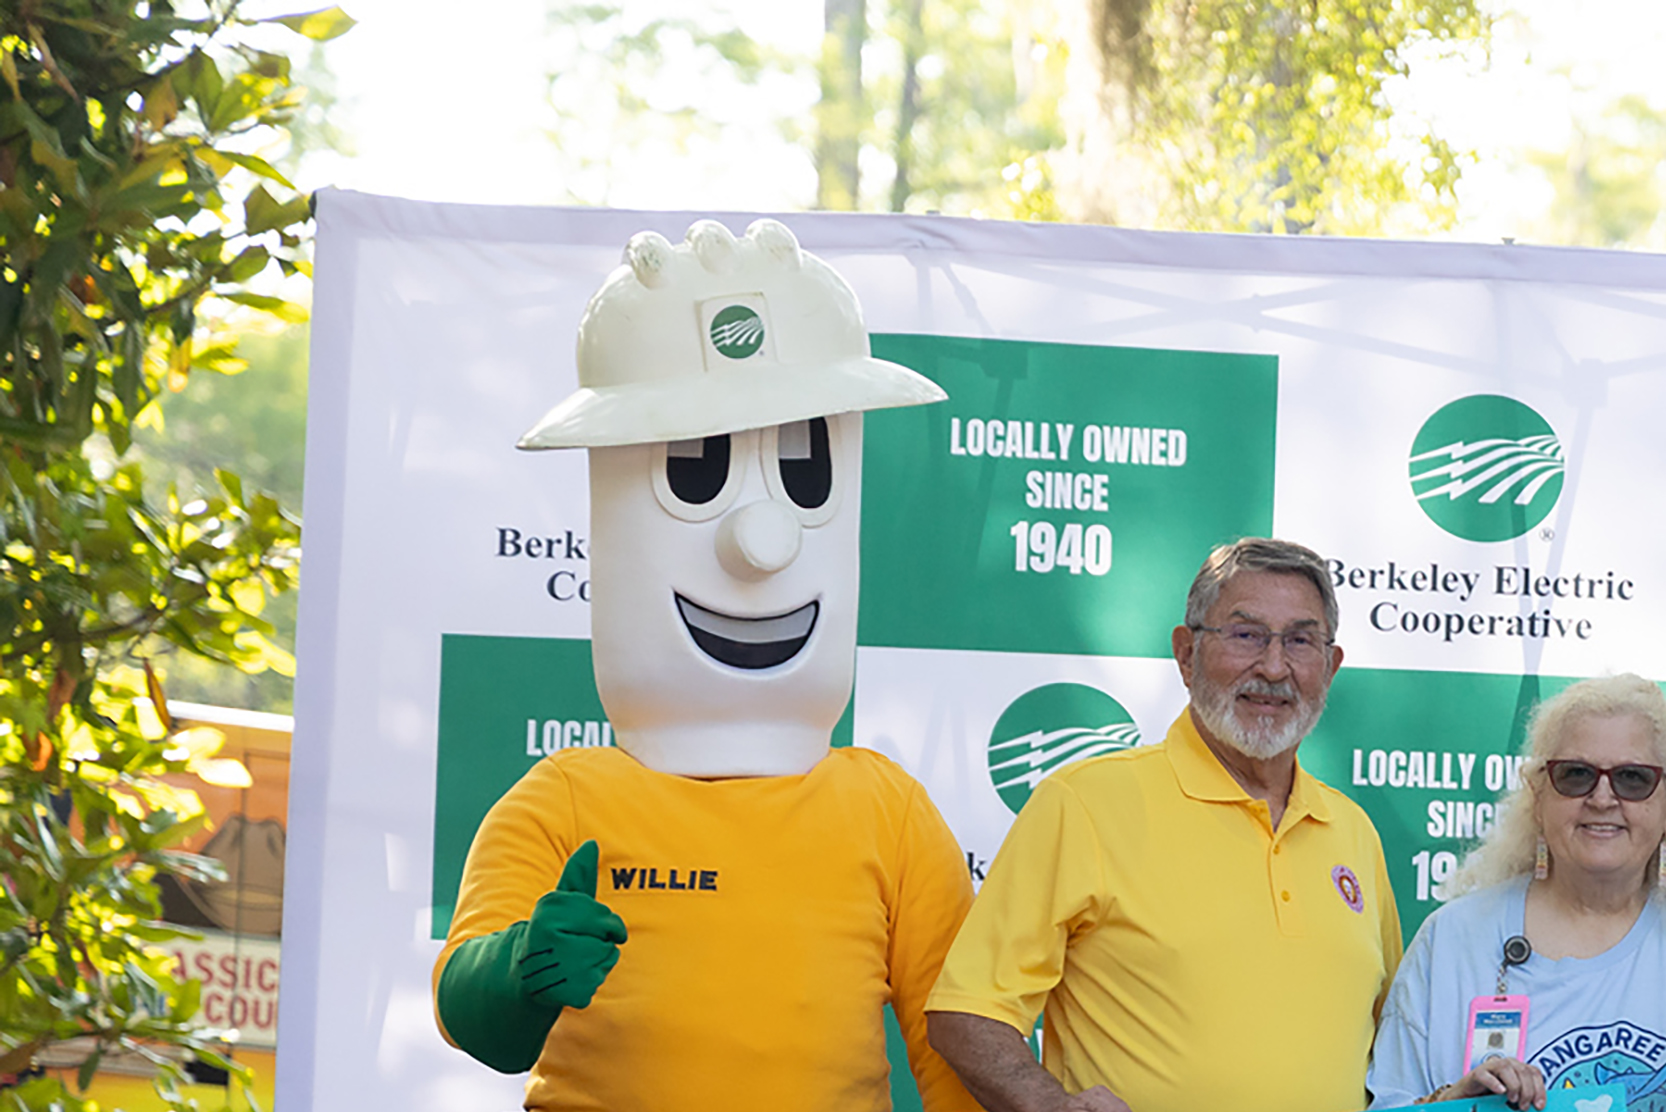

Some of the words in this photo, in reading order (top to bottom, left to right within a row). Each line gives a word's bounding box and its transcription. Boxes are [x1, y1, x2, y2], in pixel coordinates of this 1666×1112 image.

[951, 418, 1074, 460] LOCALLY
[1083, 425, 1187, 466] OWNED
[1025, 471, 1109, 511] SINCE
[496, 527, 590, 559] Berk
[1010, 521, 1112, 575] 1940
[1325, 559, 1480, 601] Berkeley
[1494, 565, 1634, 600] Electric
[1369, 601, 1592, 642] Cooperative
[1353, 749, 1476, 789] LOCALLY
[611, 867, 718, 891] WILLIE
[203, 993, 277, 1029] COU
[1538, 1027, 1666, 1080] ANGAREE
